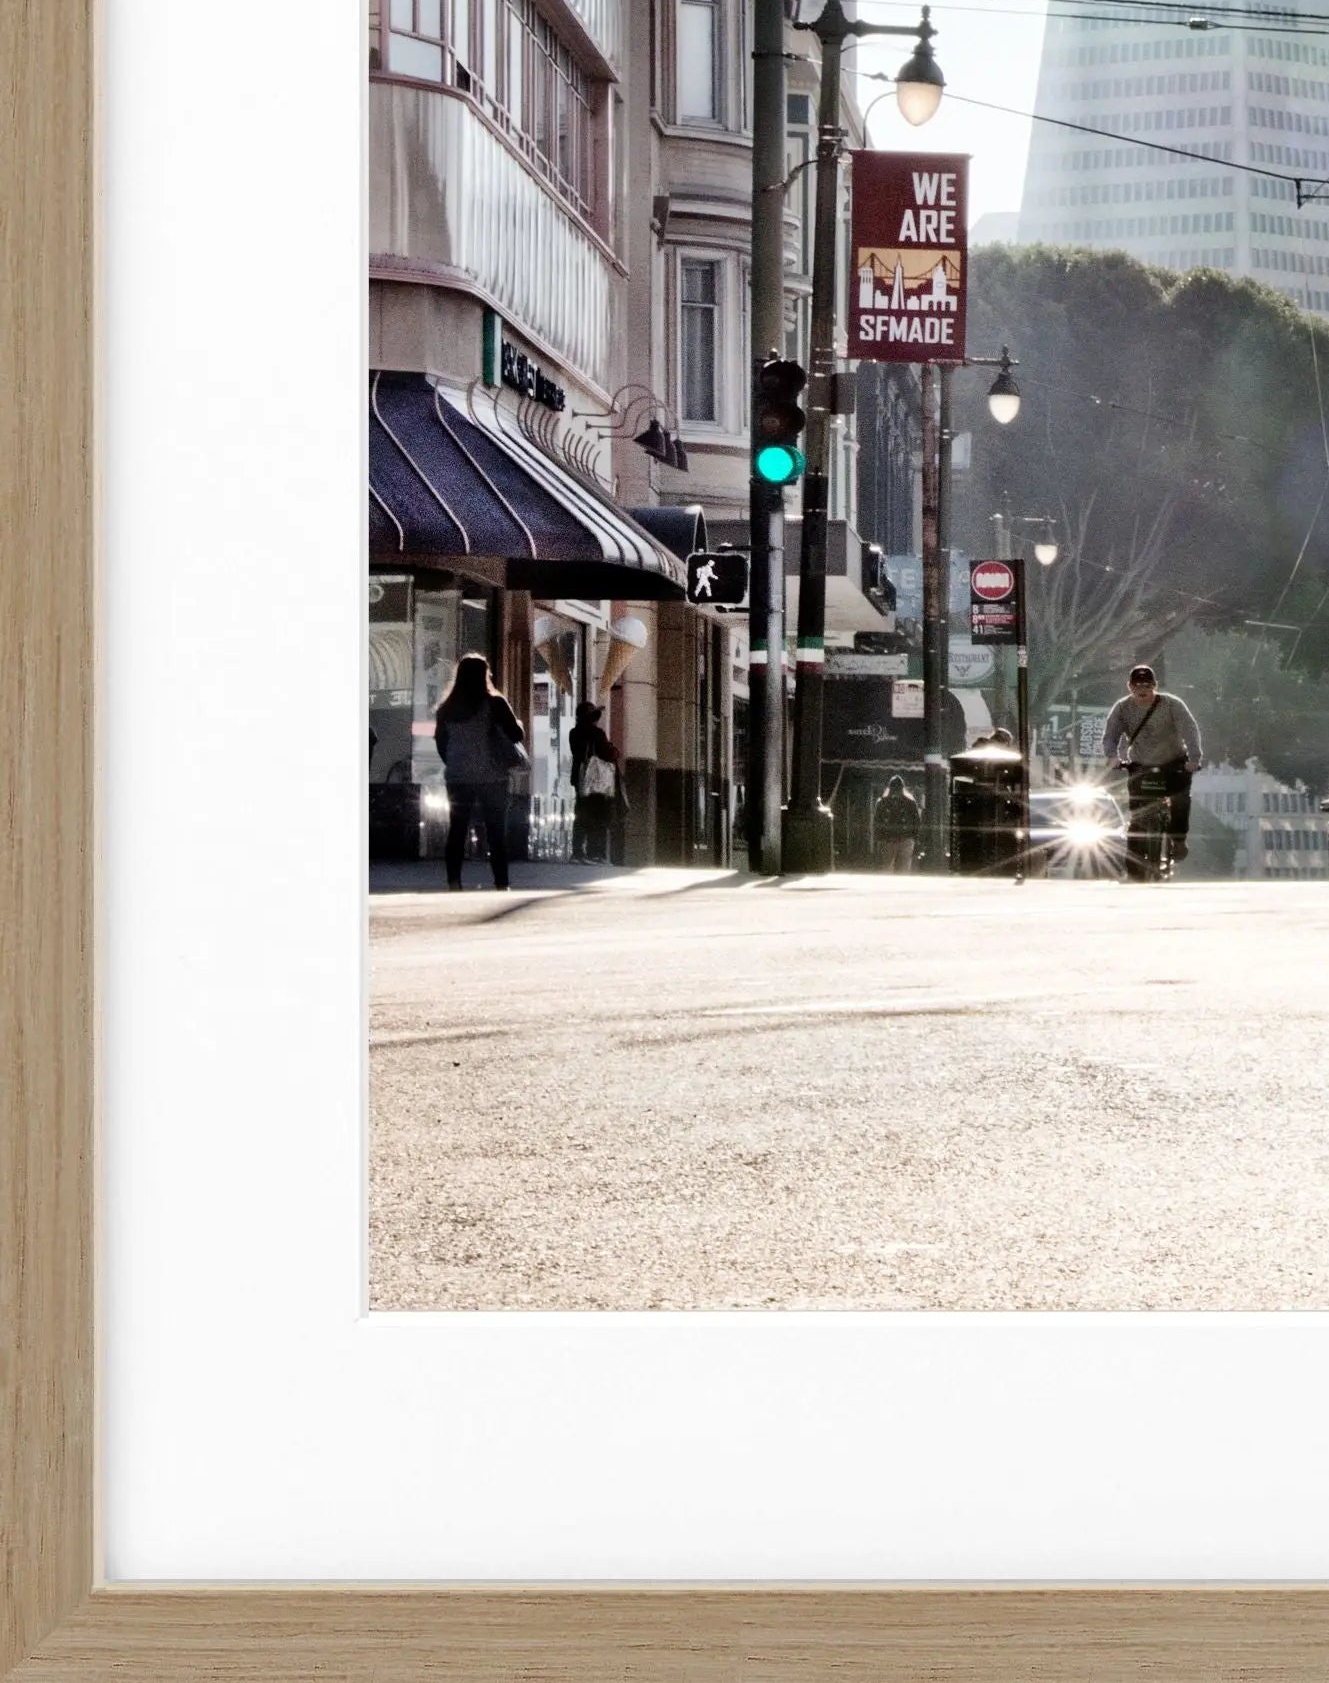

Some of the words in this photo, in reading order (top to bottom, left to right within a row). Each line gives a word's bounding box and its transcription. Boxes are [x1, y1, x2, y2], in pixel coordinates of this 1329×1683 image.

[912, 172, 957, 206] WE
[898, 209, 956, 243] ARE
[859, 314, 954, 345] SFMADE
[972, 625, 984, 634] 41
